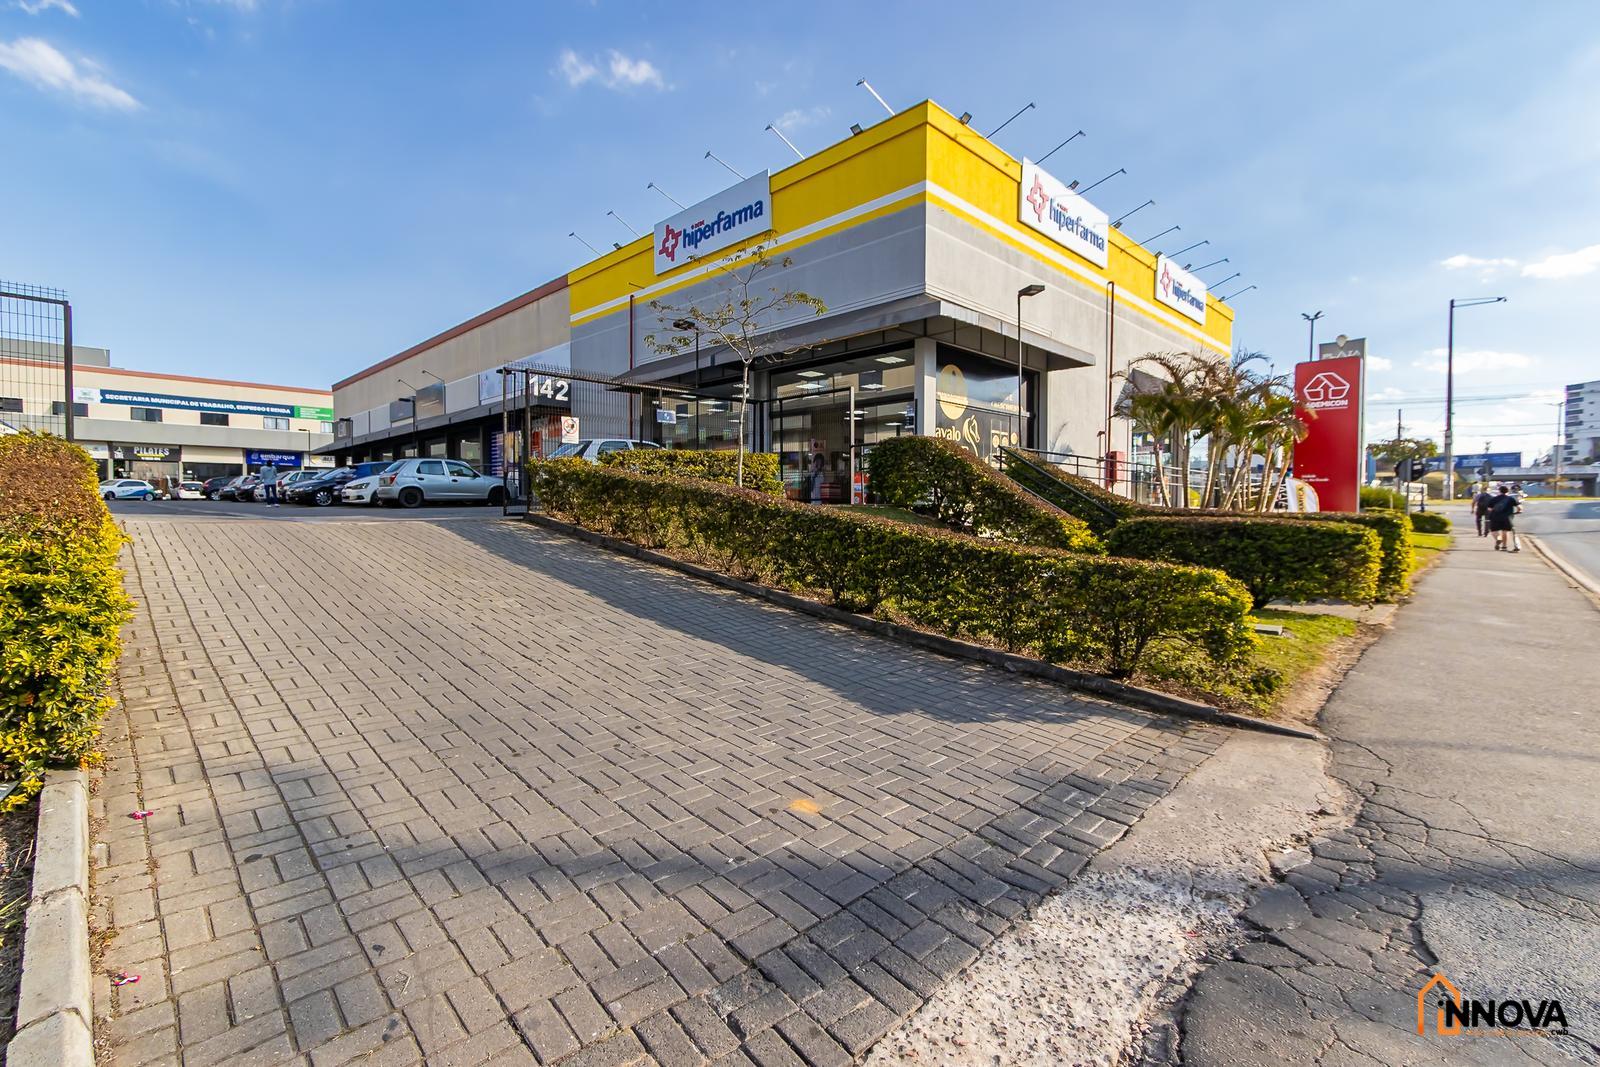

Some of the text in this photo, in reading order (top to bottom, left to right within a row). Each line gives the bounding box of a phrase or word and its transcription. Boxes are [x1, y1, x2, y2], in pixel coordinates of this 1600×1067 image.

[682, 199, 764, 249] hiperfarma
[1049, 197, 1105, 252] hiperfarma
[528, 375, 569, 402] 142
[105, 393, 150, 402] SECRETARIA
[150, 397, 190, 406] MUNICIPAL
[935, 425, 961, 442] avalo
[133, 446, 170, 456] PILATES
[259, 453, 296, 461] embarque
